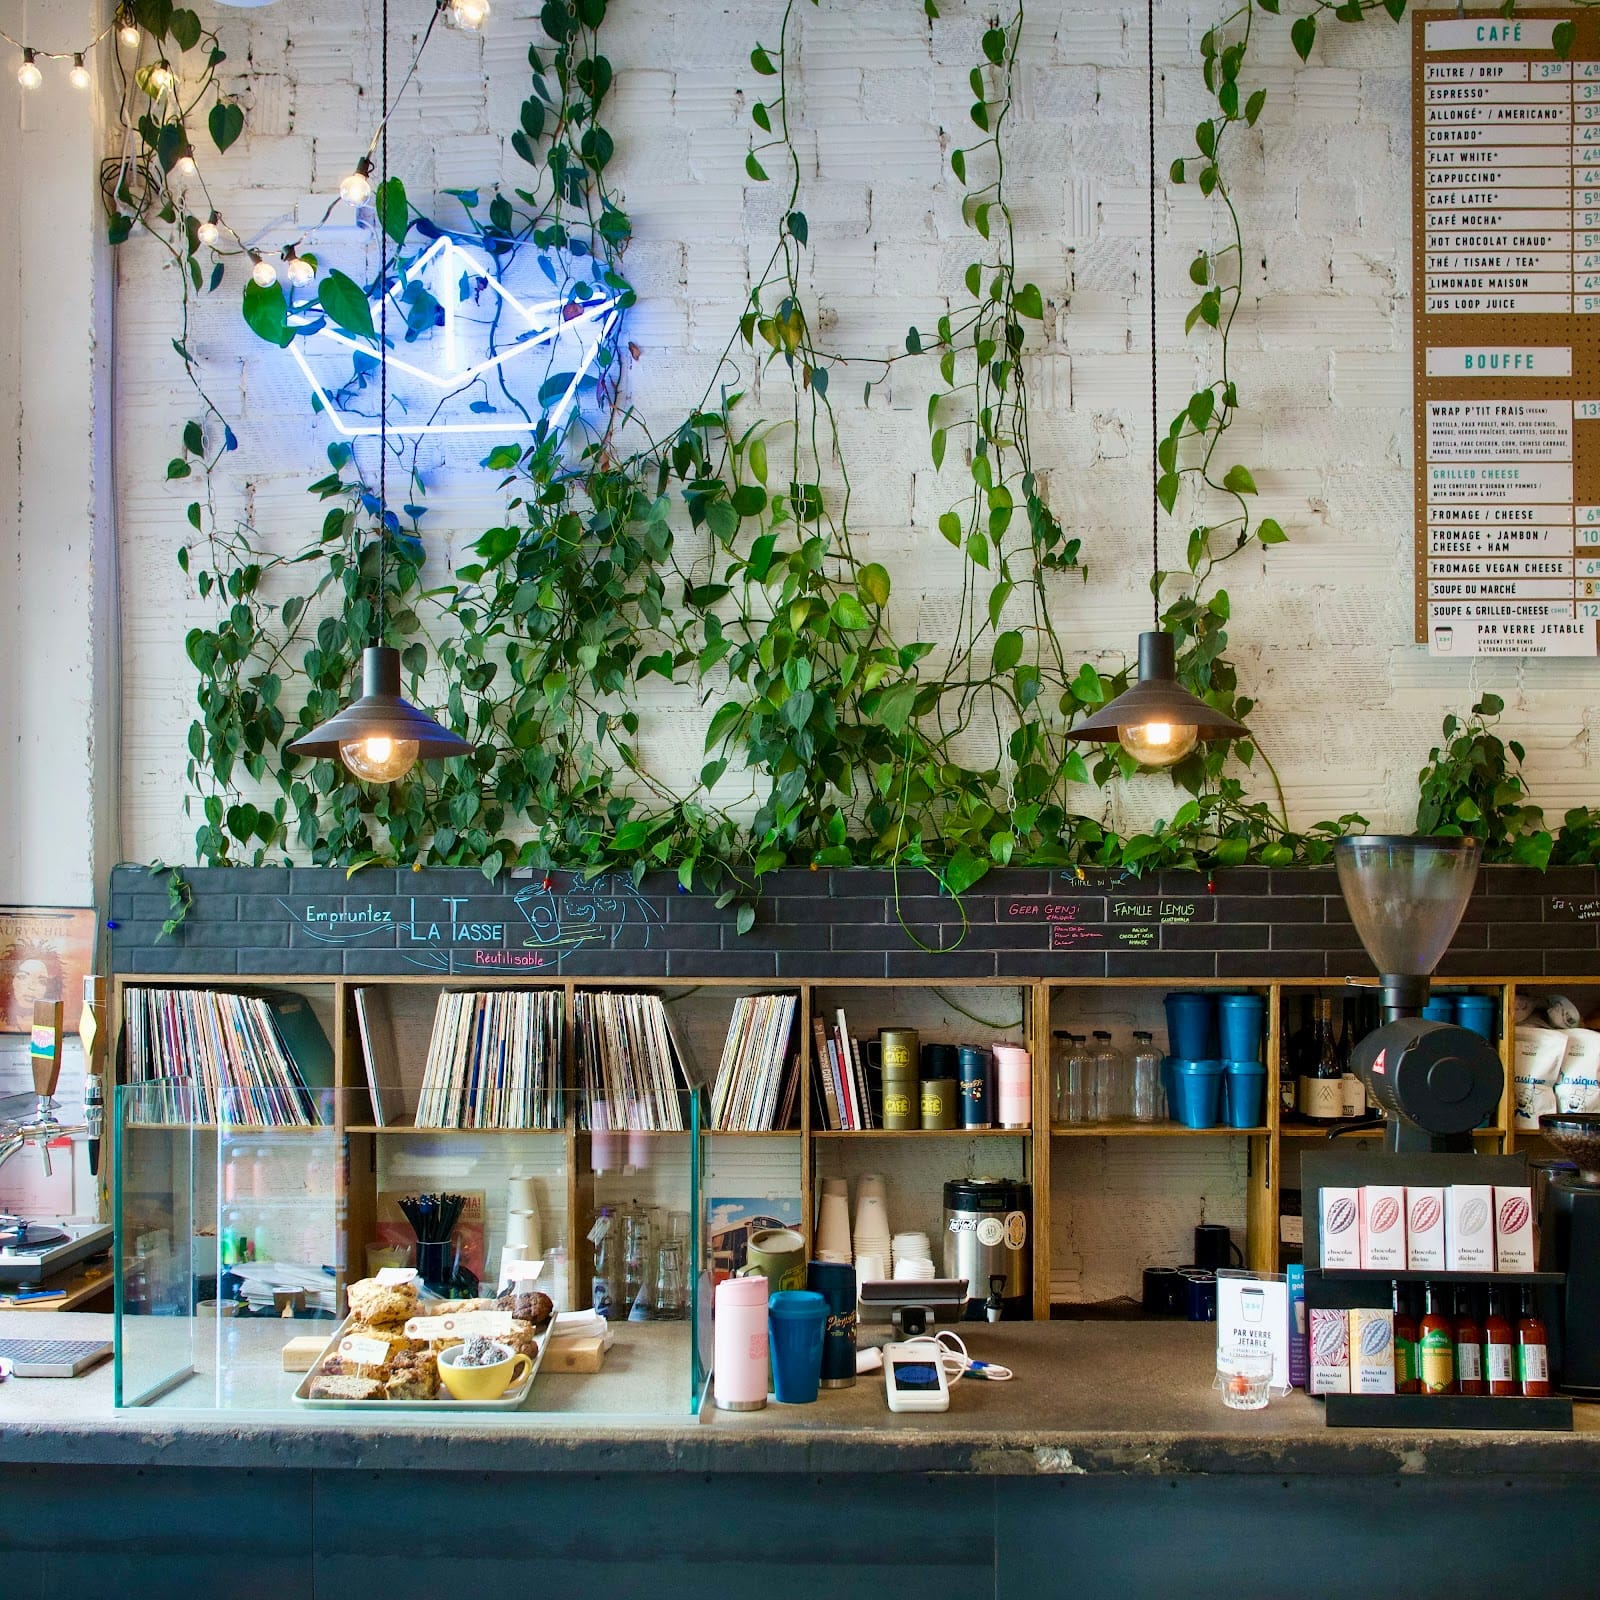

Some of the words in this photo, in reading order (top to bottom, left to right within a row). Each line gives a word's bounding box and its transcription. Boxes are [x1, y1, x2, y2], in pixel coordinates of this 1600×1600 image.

[1477, 23, 1522, 41] CAFÉ
[1430, 68, 1464, 77] FILTRE
[1480, 68, 1503, 76] DRIP
[1430, 153, 1454, 162] FLAT
[1430, 193, 1456, 204] CAFÉ
[1431, 214, 1456, 225] CAFÉ
[1431, 237, 1449, 246] HOT
[1456, 237, 1507, 246] CHOCOLAT
[1431, 258, 1449, 267] THÉ
[1464, 258, 1500, 266] TISANE
[1431, 279, 1483, 288] LIMONADE
[1489, 279, 1528, 288] MAISON
[1431, 300, 1449, 309] JUS
[1455, 300, 1480, 308] LOOP
[1486, 299, 1515, 308] JUICE
[1465, 354, 1534, 369] BOUFFE
[1432, 407, 1460, 416] WRAP
[1466, 407, 1490, 416] P'TIT
[1496, 407, 1524, 415] FRAIS
[1434, 470, 1475, 479] GRILLED
[1482, 470, 1520, 478] CHEESE
[1433, 511, 1480, 520] FROMAGE
[1495, 510, 1533, 519] CHEESE
[1433, 531, 1480, 540] FROMAGE
[1498, 531, 1538, 539] JAMBON
[1433, 543, 1471, 552] CHEESE
[1488, 542, 1509, 551] HAM
[1433, 564, 1480, 572] FROMAGE
[1486, 563, 1519, 572] VEGAN
[1525, 563, 1563, 572] CHEESE
[1434, 585, 1462, 594] SOUPE
[1466, 585, 1476, 594] DU
[1481, 582, 1516, 594] MARCHÉ
[1434, 607, 1462, 616] SOUPE
[1476, 606, 1549, 615] GRILLED-CHEESE
[1478, 625, 1497, 634] PAR
[1503, 625, 1535, 634] VERRE
[1541, 625, 1584, 634] JETABLE
[1113, 902, 1153, 917] FAMILLE
[1159, 901, 1195, 916] LEMUS
[306, 903, 392, 930] Empruntez
[410, 898, 441, 941] LA
[475, 950, 544, 967] Réutilisable
[822, 1068, 835, 1096] COFFEE
[1234, 1329, 1246, 1337] PAR
[1250, 1330, 1271, 1339] VERRE
[1238, 1338, 1267, 1347] JETABLE
